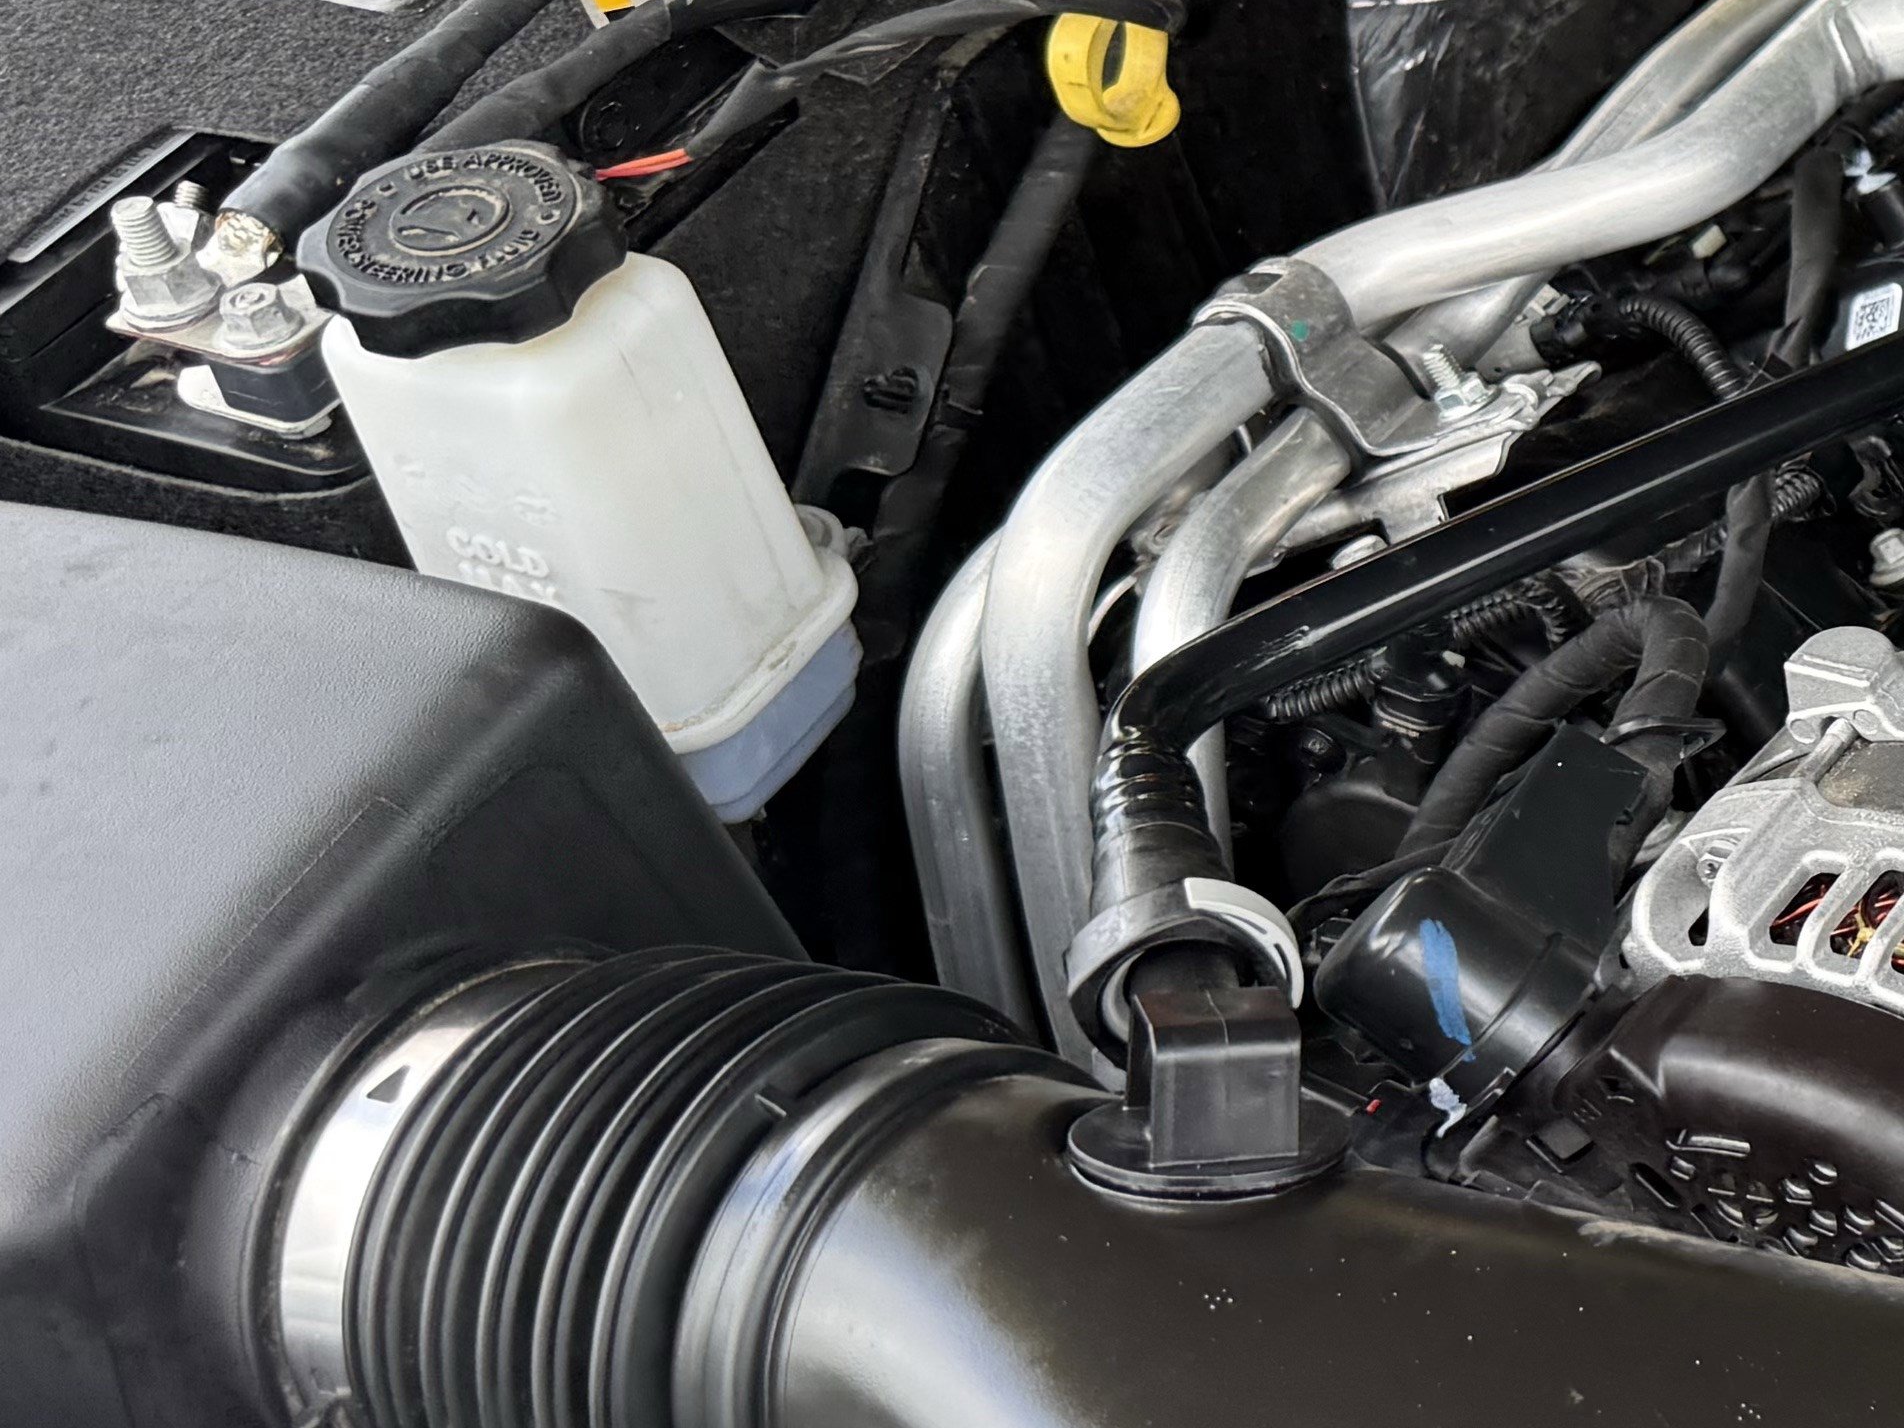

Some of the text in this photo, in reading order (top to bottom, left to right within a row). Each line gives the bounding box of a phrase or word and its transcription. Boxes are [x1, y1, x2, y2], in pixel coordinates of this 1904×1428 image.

[463, 153, 564, 204] APPROVED
[345, 250, 471, 283] STEERING
[446, 526, 550, 578] COLD
